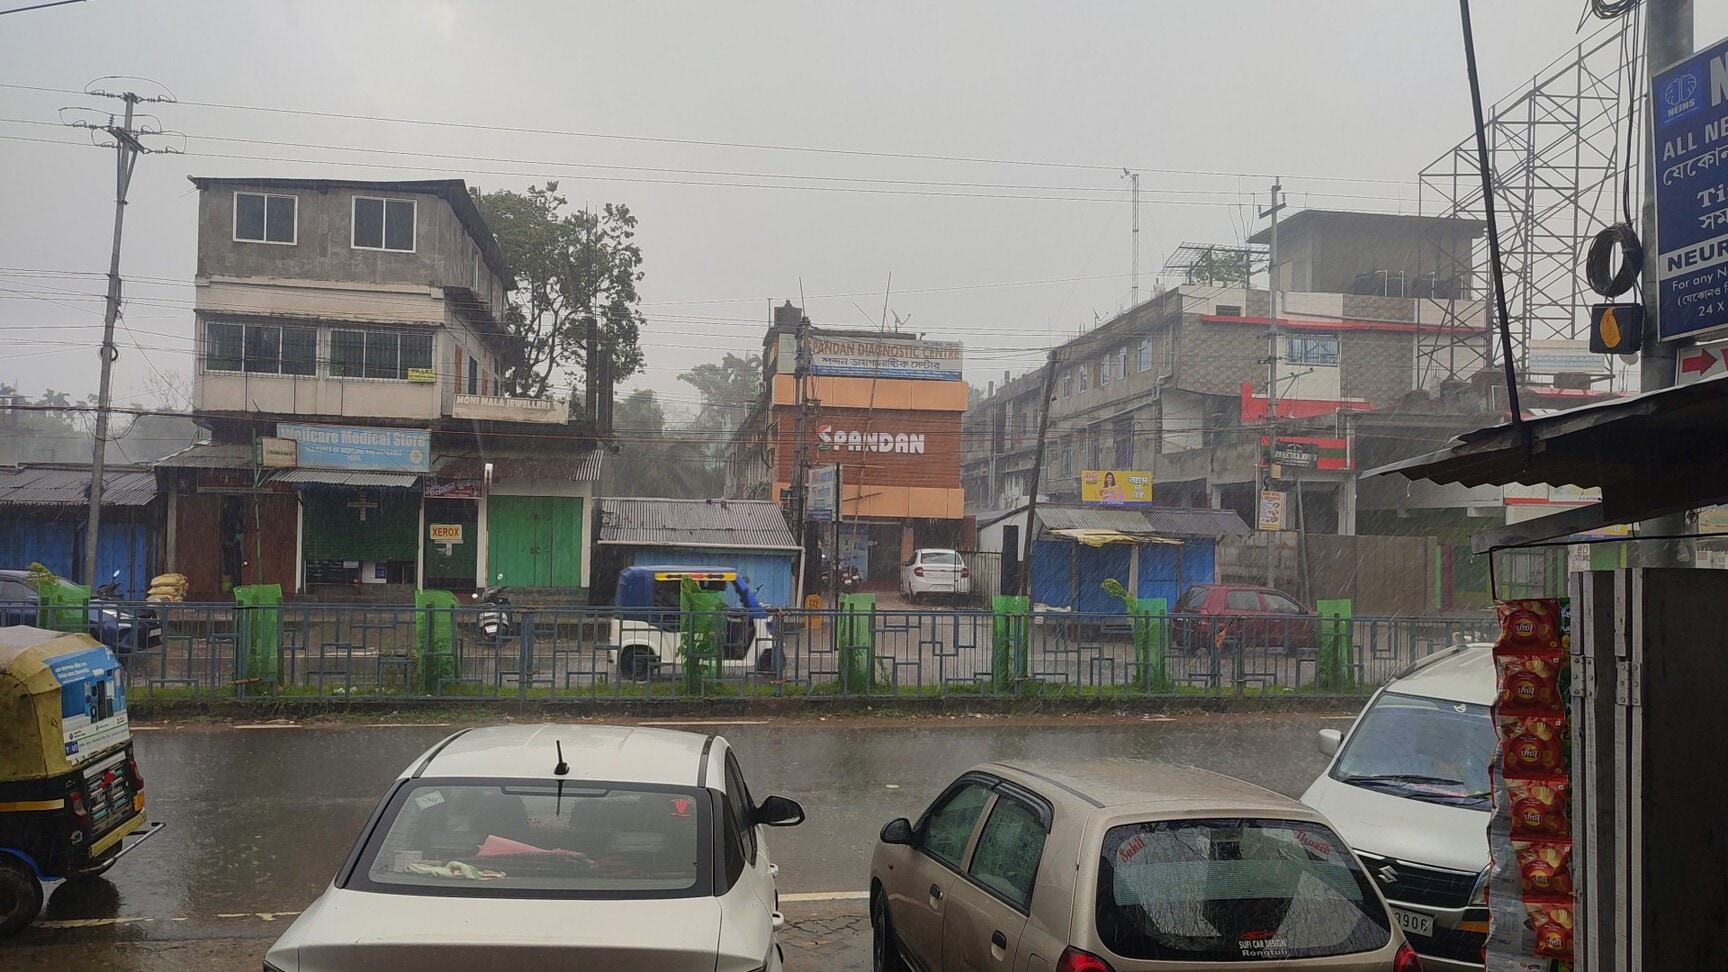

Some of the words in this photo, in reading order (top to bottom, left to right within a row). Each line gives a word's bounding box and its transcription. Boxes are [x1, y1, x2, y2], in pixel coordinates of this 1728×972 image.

[1667, 98, 1696, 117] NEINS
[1662, 131, 1698, 162] ALL
[1673, 279, 1689, 291] For
[1693, 273, 1713, 286] any
[1698, 304, 1713, 317] 24
[1717, 301, 1725, 312] X
[857, 342, 920, 358] DIAGNOSTIC
[922, 346, 960, 359] CENTRE
[456, 395, 479, 405] MONI
[481, 397, 505, 407] MALA
[506, 399, 551, 410] JEWELLERS
[341, 430, 390, 446] Medical
[393, 433, 425, 447] Store
[818, 425, 925, 454] SPANDAN
[432, 527, 459, 537] XEROX
[1238, 940, 1252, 949] SUFI
[1253, 940, 1264, 949] CAR
[1265, 938, 1288, 948] DESIGN
